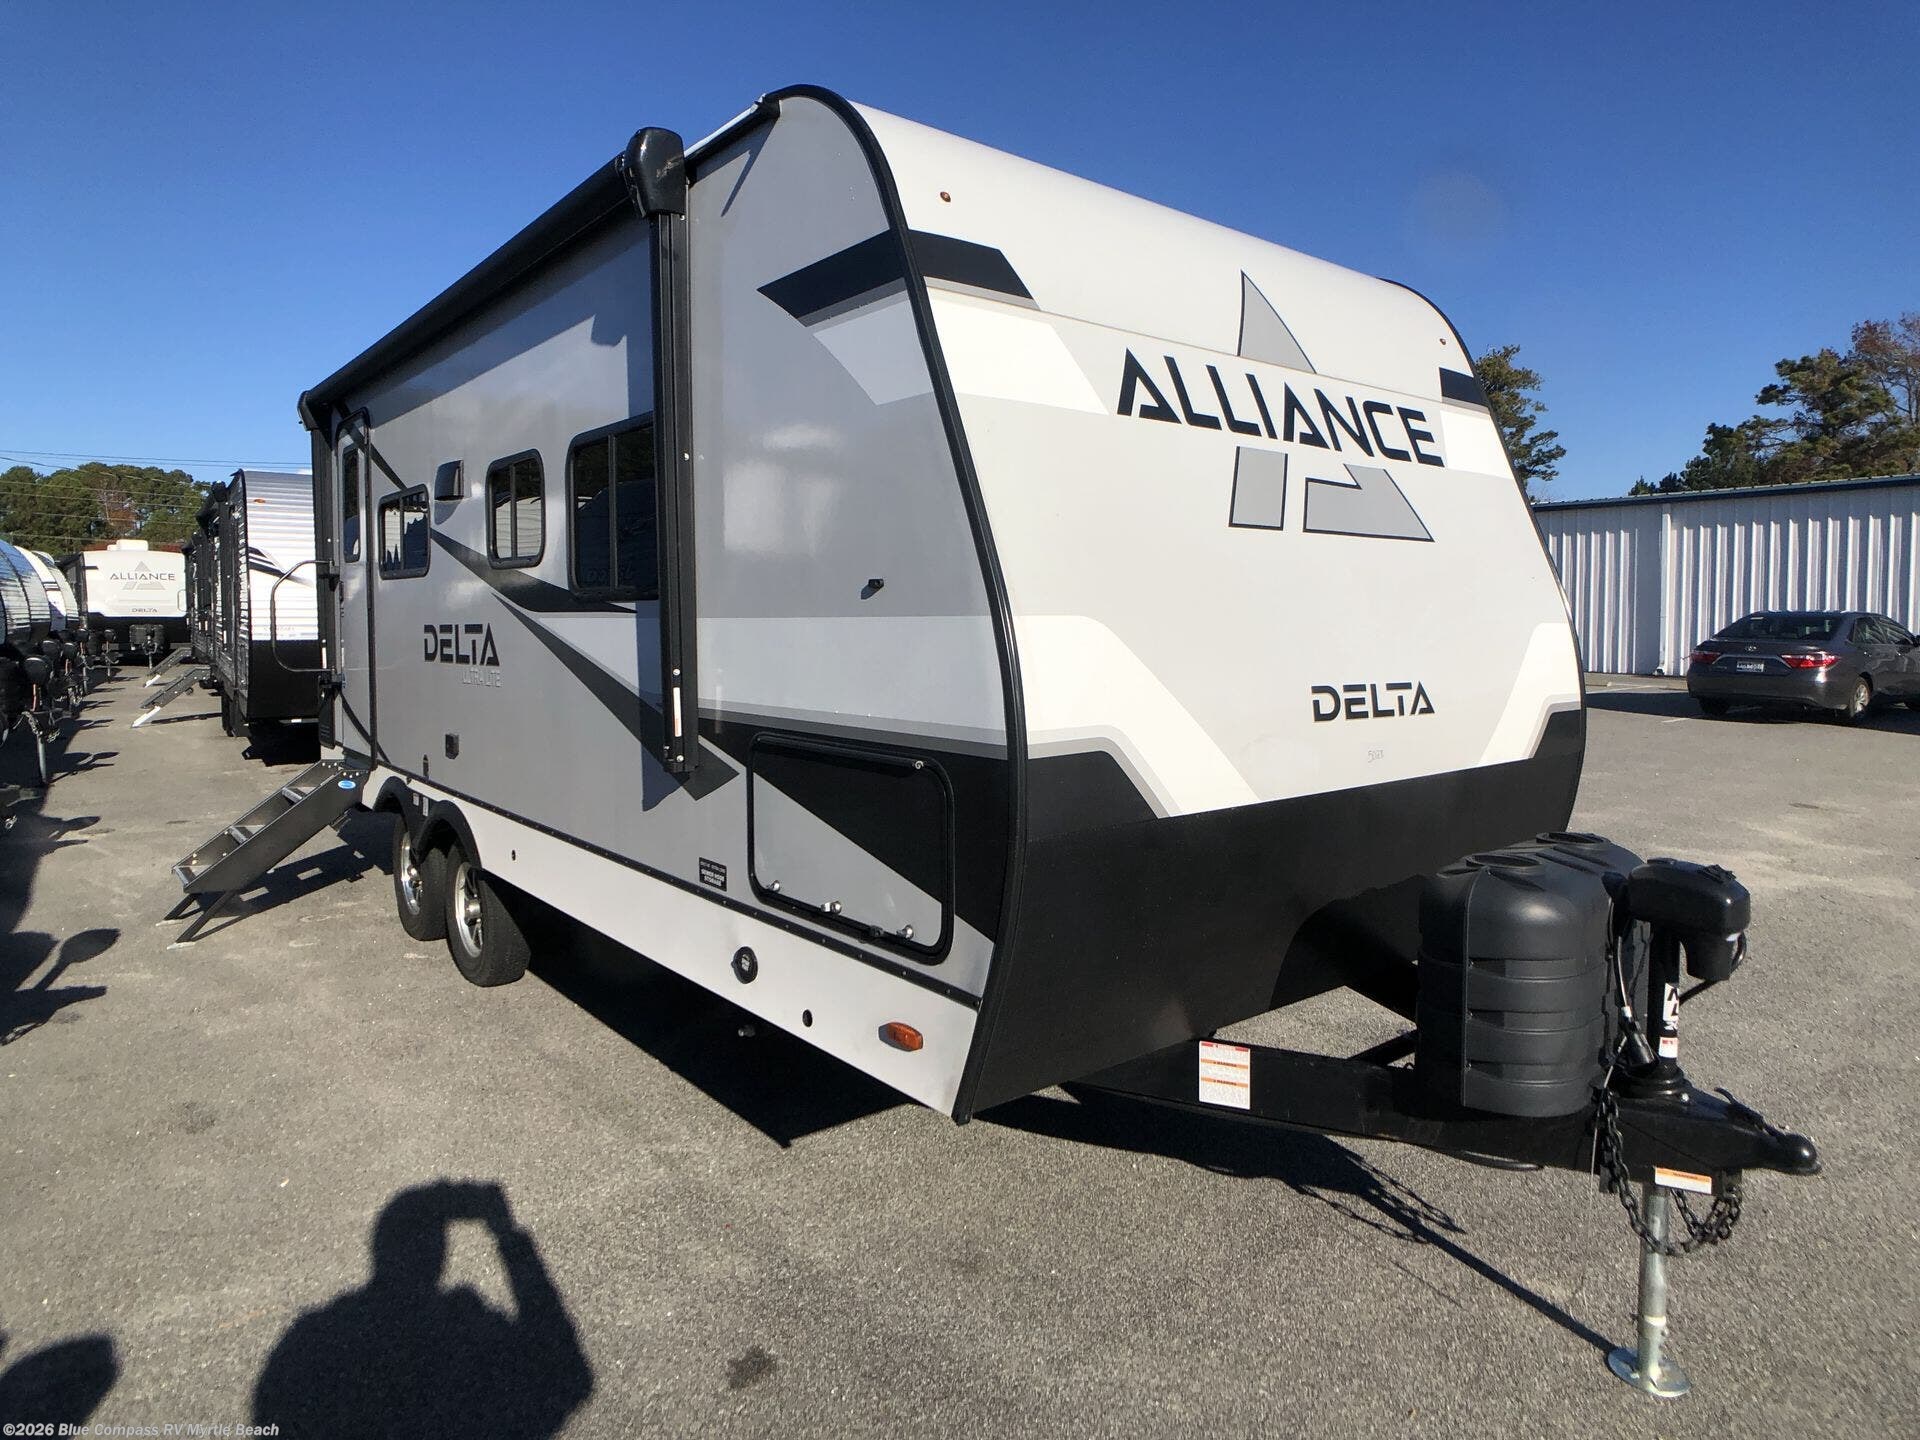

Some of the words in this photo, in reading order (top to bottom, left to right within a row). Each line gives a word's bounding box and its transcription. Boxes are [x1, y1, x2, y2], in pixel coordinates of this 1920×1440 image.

[1117, 347, 1445, 467] ALLIANCE
[110, 573, 175, 581] ALLIANCE
[424, 623, 500, 666] DELTA
[1311, 681, 1435, 723] DELTA
